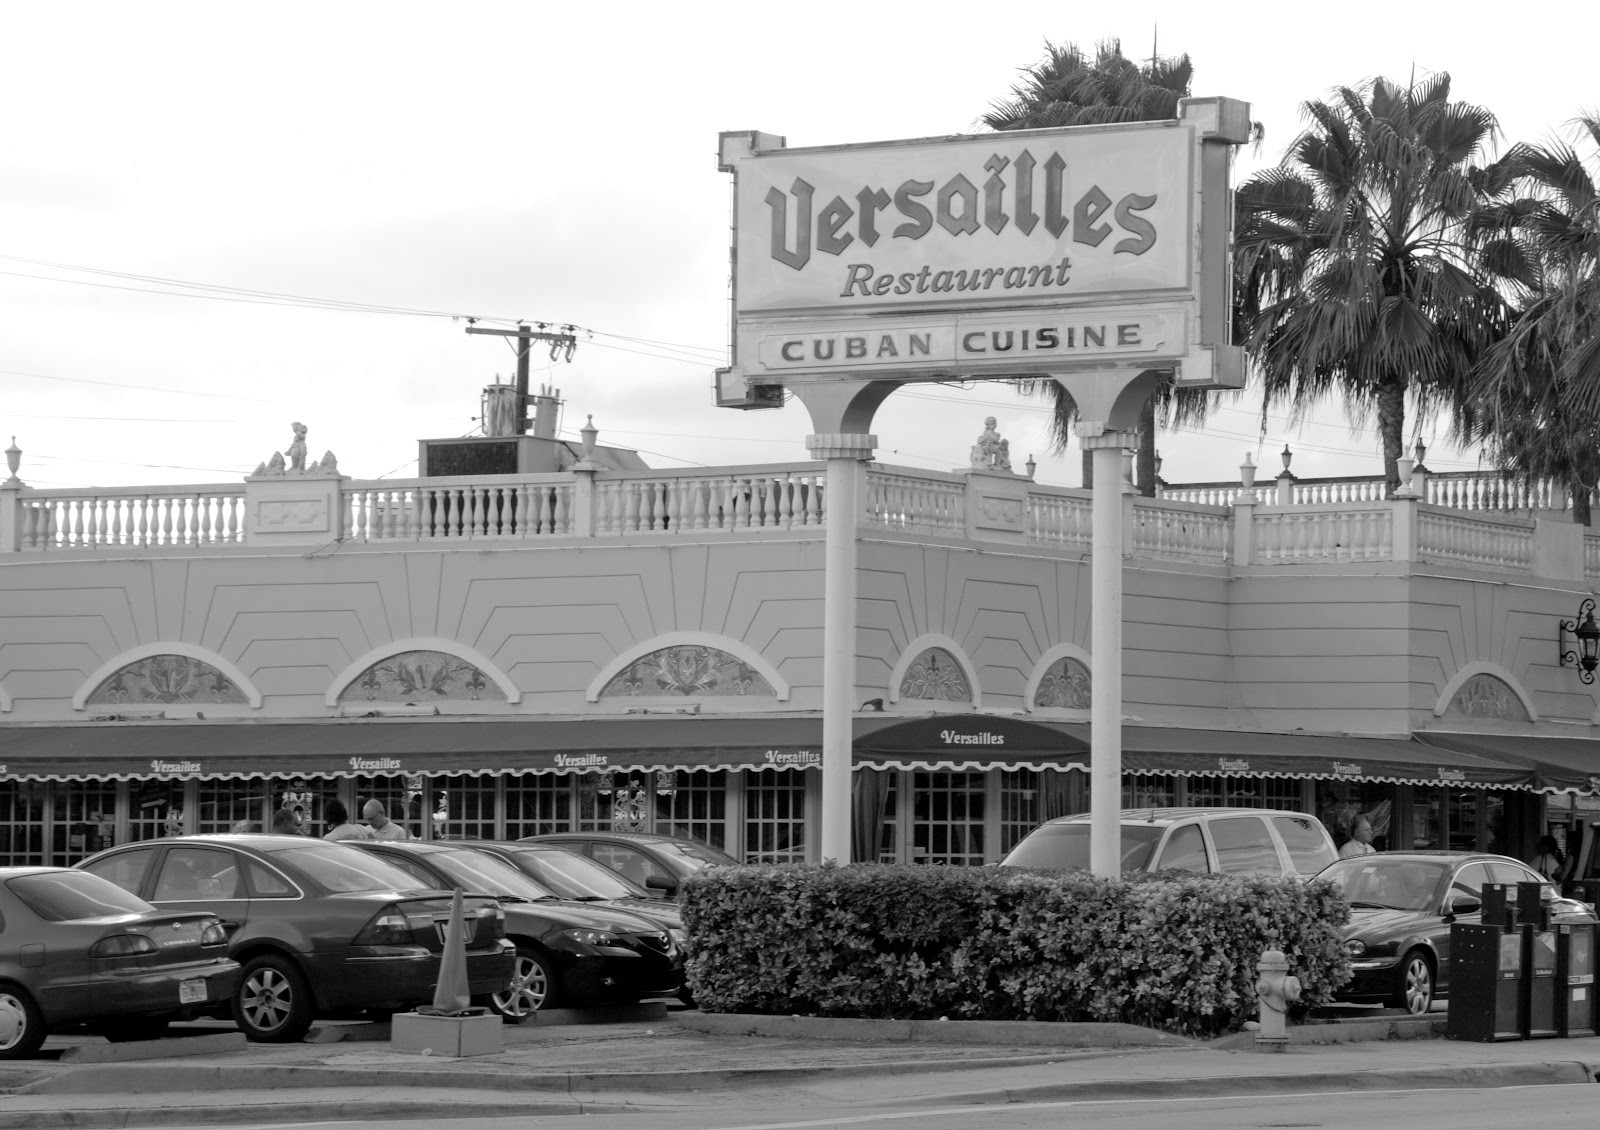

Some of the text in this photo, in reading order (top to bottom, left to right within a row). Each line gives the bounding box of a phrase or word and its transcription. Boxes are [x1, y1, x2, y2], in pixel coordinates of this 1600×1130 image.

[765, 148, 1158, 271] Versailles
[840, 257, 1072, 298] Restaurant
[781, 323, 1142, 361] CUBAN CUISINE
[940, 730, 1005, 745] Versailles
[349, 756, 401, 770] Versailles
[554, 753, 608, 767] Versailles
[765, 750, 821, 763] Versailles
[150, 760, 201, 773] Versailles
